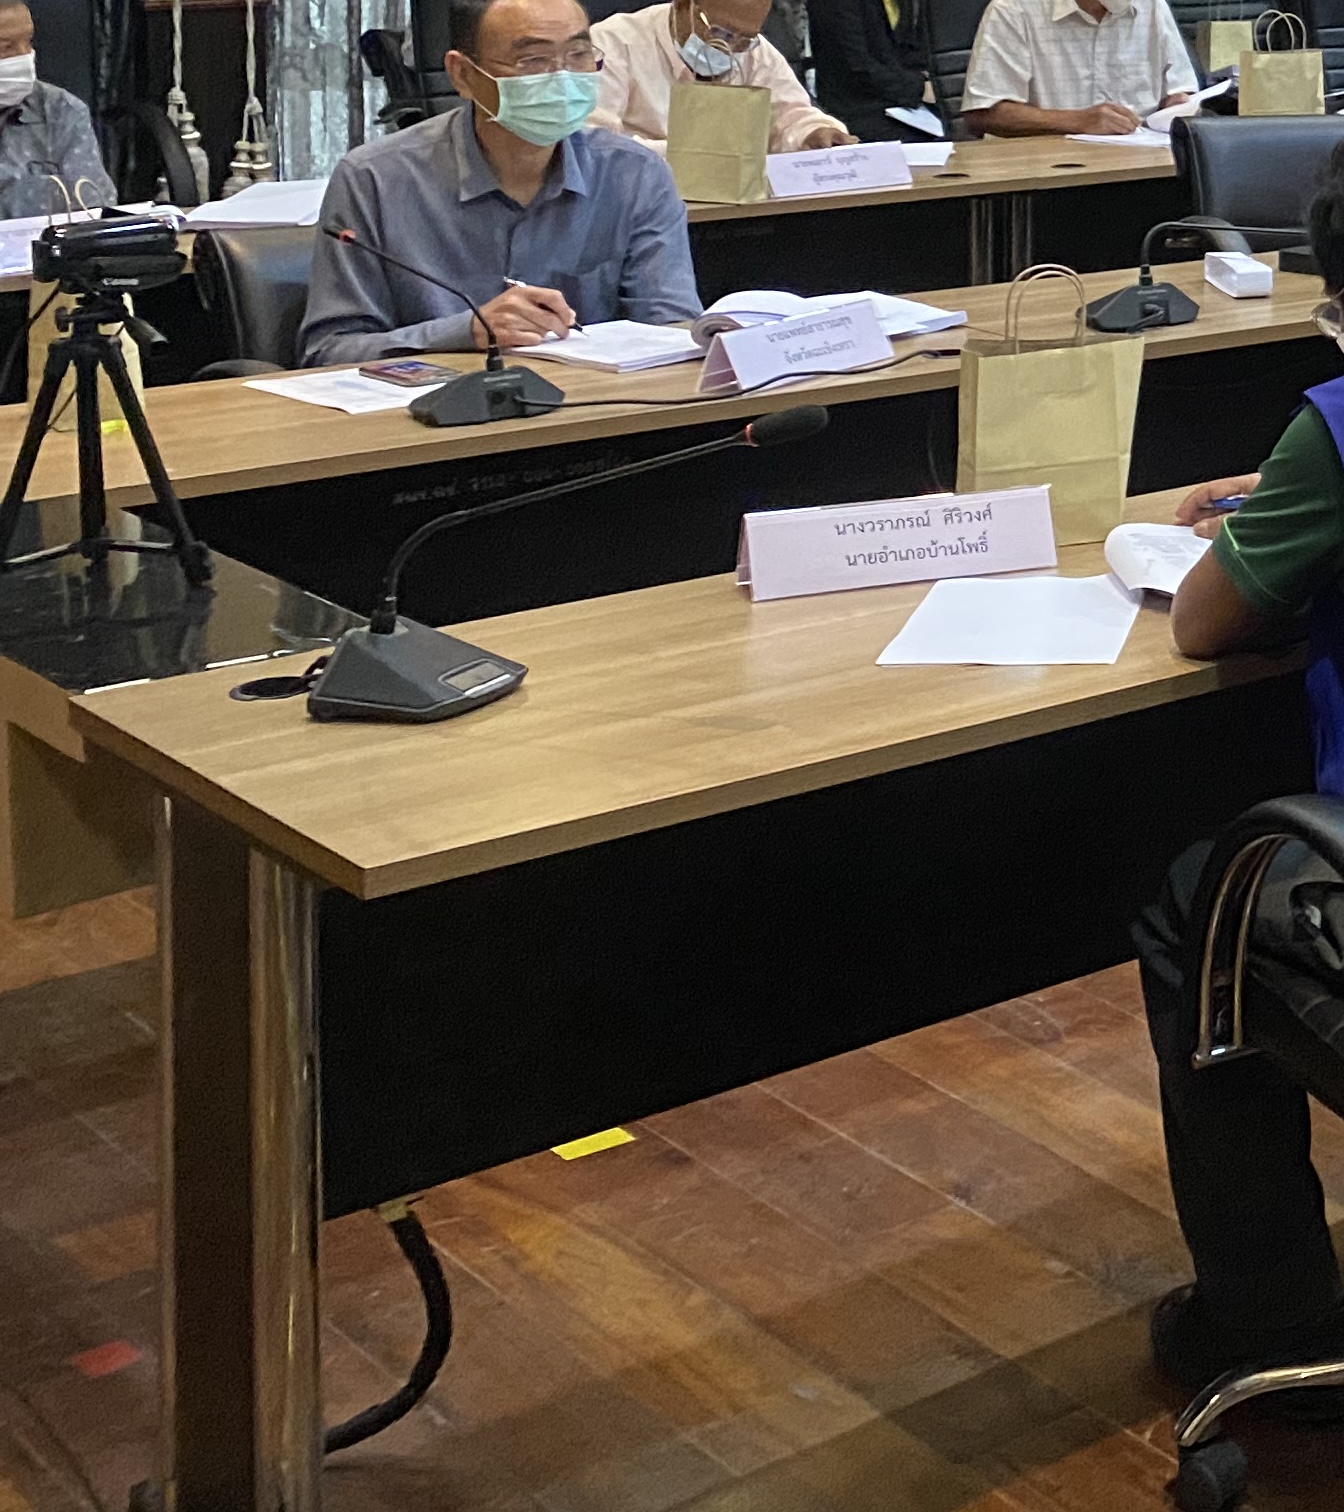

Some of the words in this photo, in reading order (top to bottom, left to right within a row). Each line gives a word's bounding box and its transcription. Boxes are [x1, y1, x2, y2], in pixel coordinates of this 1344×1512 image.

[833, 509, 931, 537] นางวราภรณ์
[942, 502, 994, 525] ศิริวงศ์
[844, 529, 990, 568] นายอำเภอบ้านโพธิ์
